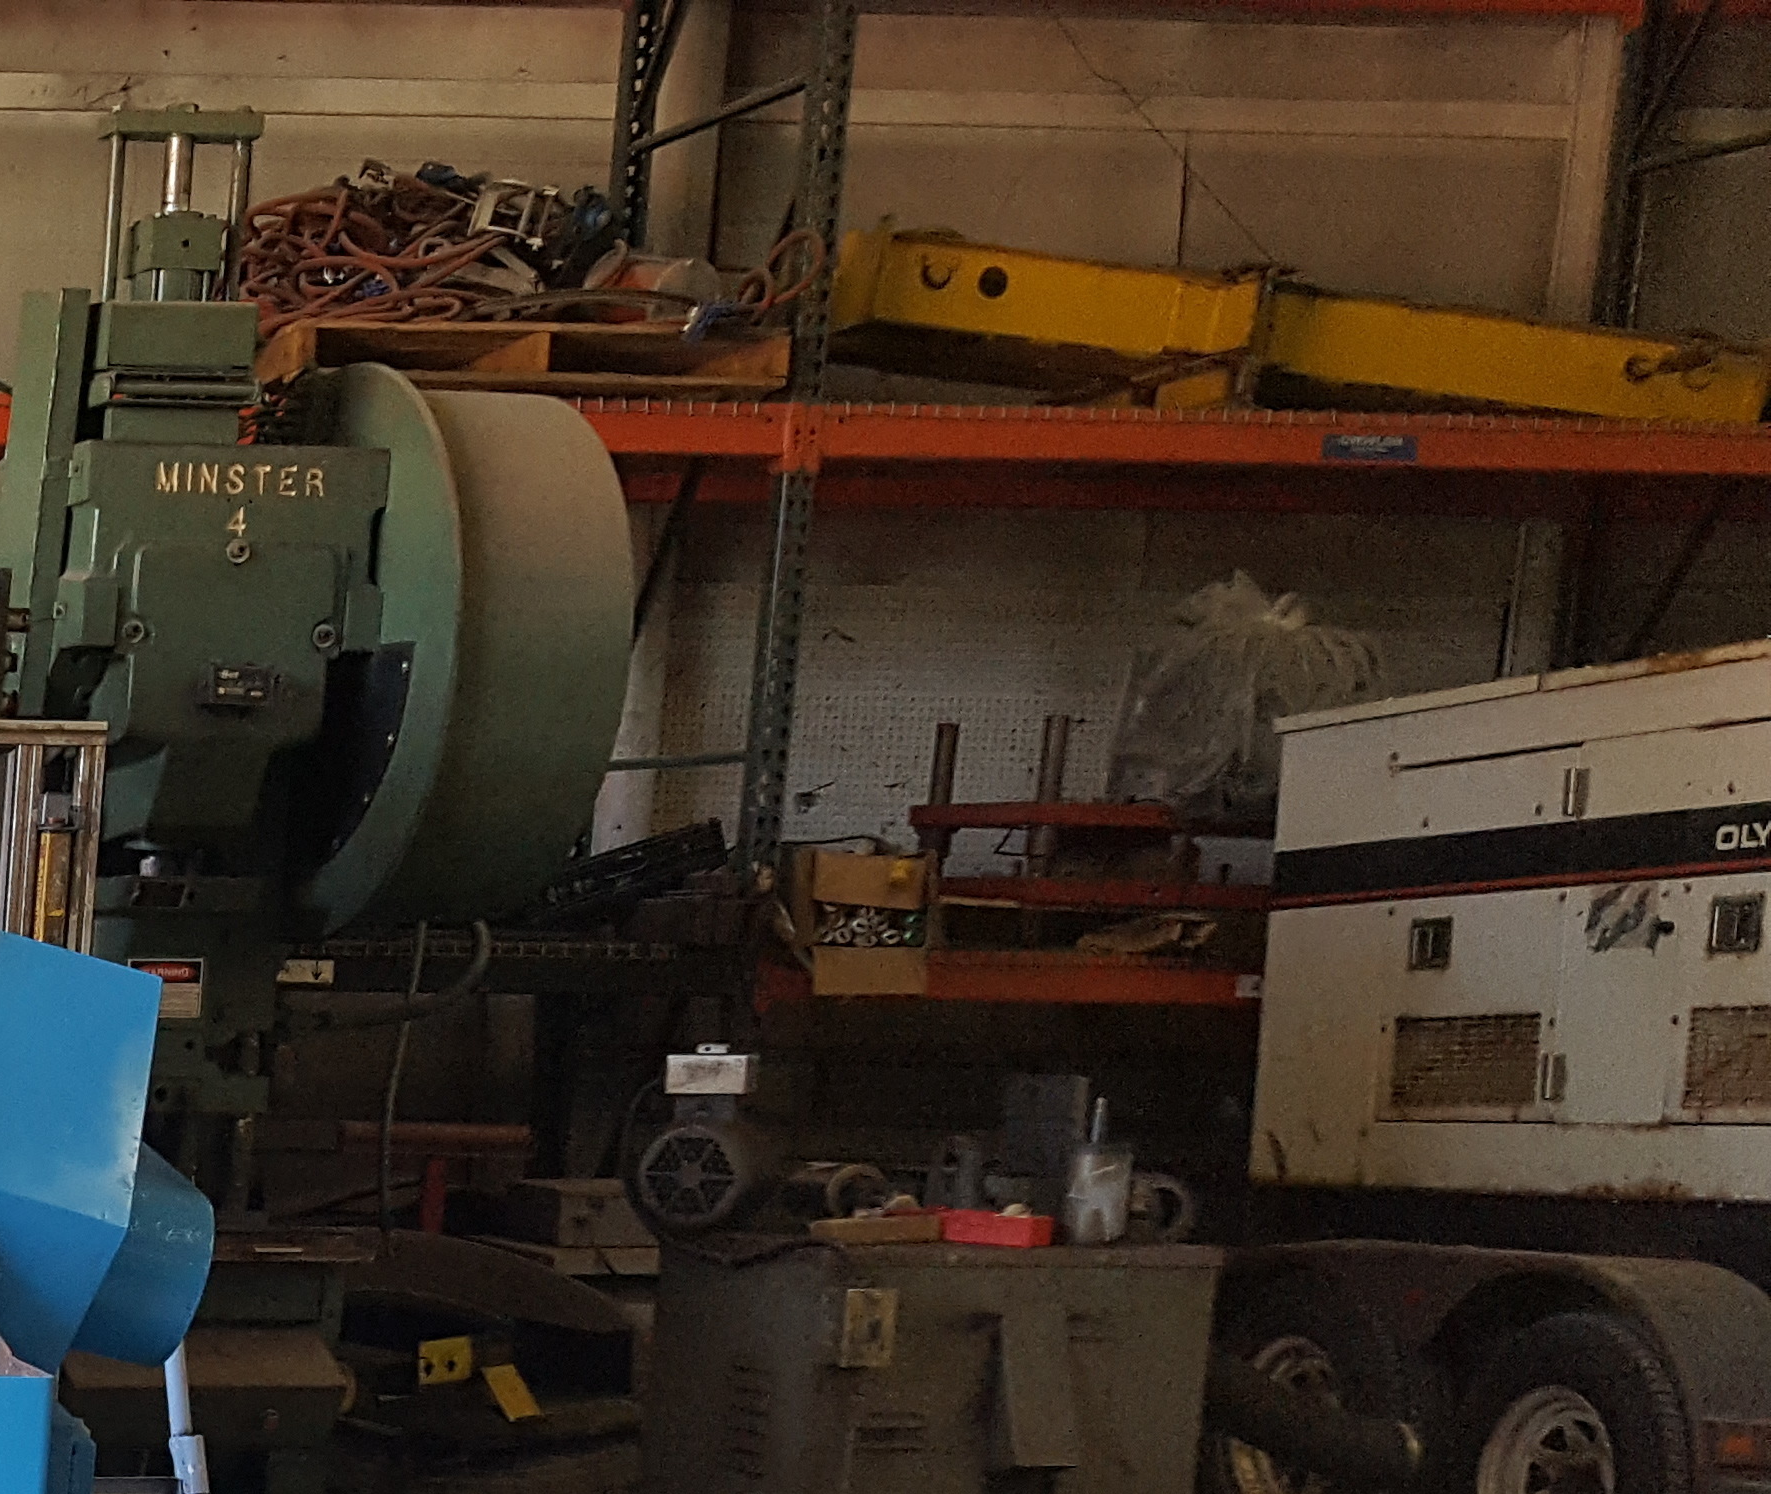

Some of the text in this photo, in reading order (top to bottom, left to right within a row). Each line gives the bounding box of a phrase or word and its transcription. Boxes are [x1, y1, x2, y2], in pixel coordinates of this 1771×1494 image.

[156, 461, 326, 498] MINSTER
[226, 506, 247, 537] 4
[1715, 820, 1771, 850] OLY
